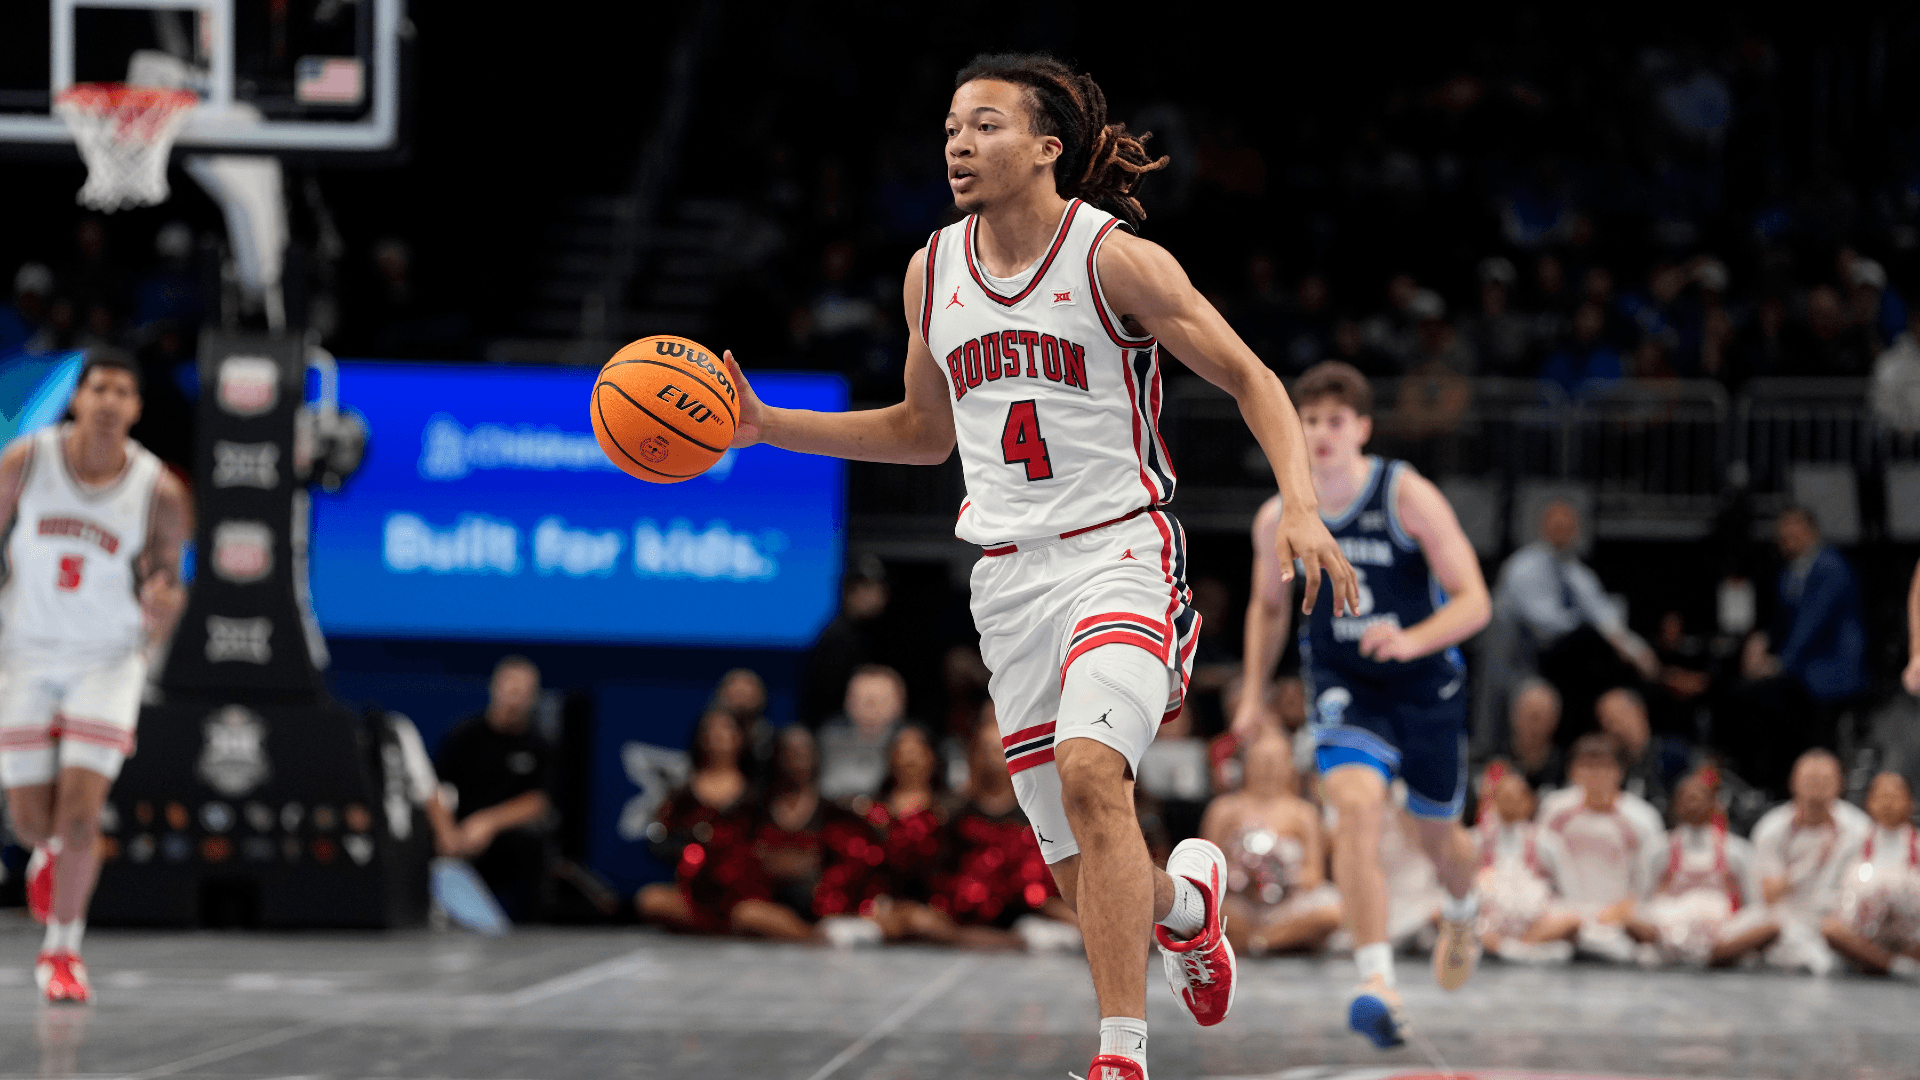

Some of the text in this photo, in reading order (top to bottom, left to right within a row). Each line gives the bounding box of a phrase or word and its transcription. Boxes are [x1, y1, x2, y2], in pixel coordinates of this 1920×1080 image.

[945, 329, 1089, 402] HOUSTON
[656, 383, 713, 423] EVO
[1000, 398, 1054, 482] 4
[384, 515, 517, 572] Built
[534, 519, 622, 574] for
